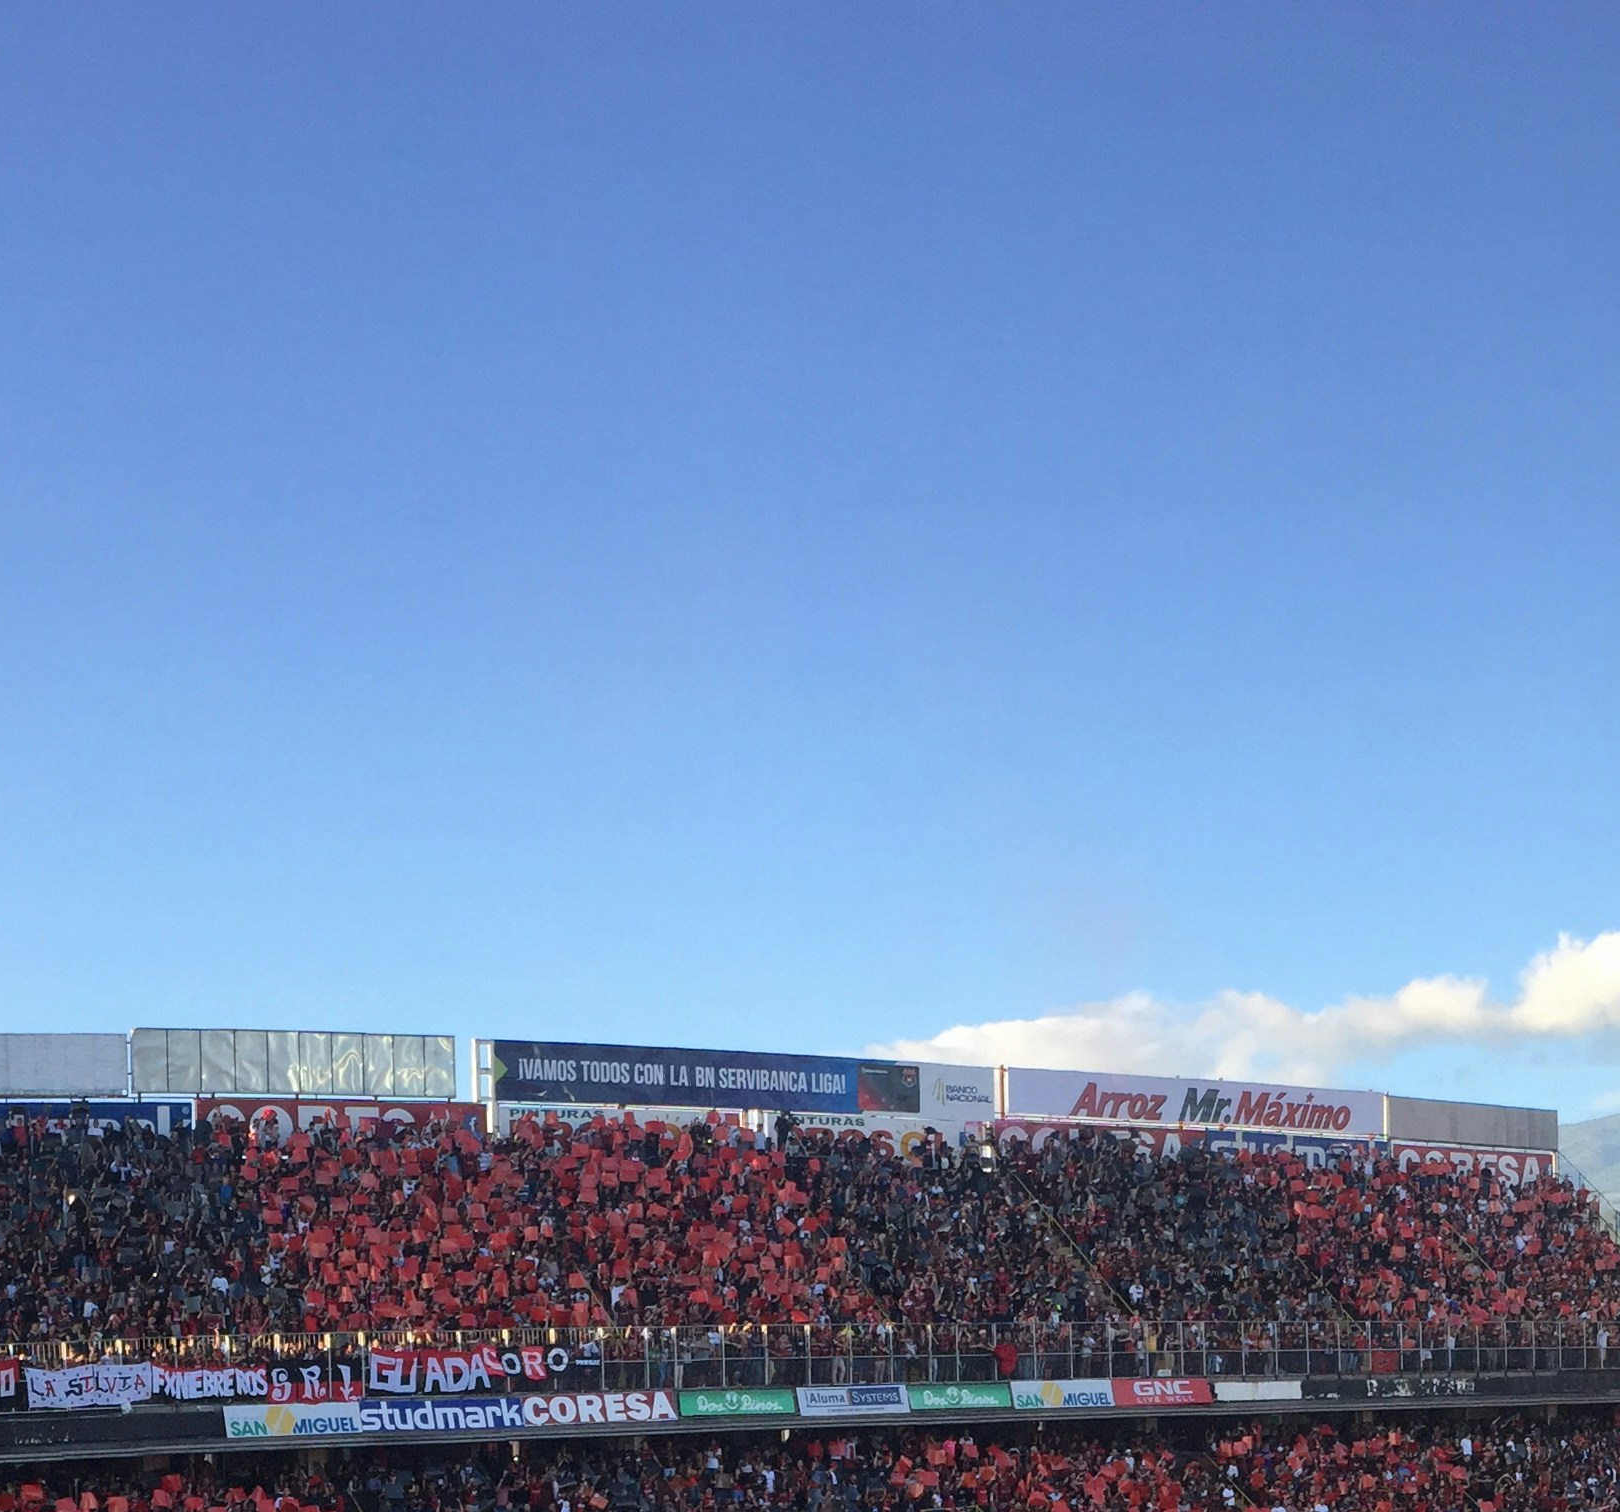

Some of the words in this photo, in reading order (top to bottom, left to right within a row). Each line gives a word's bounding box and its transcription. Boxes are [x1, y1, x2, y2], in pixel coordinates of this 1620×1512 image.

[518, 1057, 576, 1084] ¡VAMOS
[580, 1060, 630, 1085] TODOS
[633, 1062, 665, 1087] CON
[669, 1064, 689, 1087] LA
[695, 1065, 715, 1089] BN
[718, 1067, 808, 1093] SERVIBANCA
[811, 1071, 846, 1095] LIGA!
[945, 1085, 978, 1096] BANCO
[945, 1093, 993, 1104] NACIONAL
[1070, 1082, 1167, 1121] Arroz
[1179, 1087, 1232, 1124] Mr.
[1234, 1091, 1352, 1132] Máximo
[29, 1374, 57, 1398] LA
[1132, 1380, 1192, 1396] GNC
[524, 1392, 677, 1425] CORESA
[808, 1391, 847, 1407] Aluma
[851, 1389, 900, 1405] SYSTEMS
[1016, 1392, 1044, 1408] SAN
[1062, 1390, 1111, 1408] MIGUEL
[361, 1398, 523, 1432] studmark
[230, 1420, 268, 1437] SAN
[292, 1416, 358, 1435] MIGUEL
